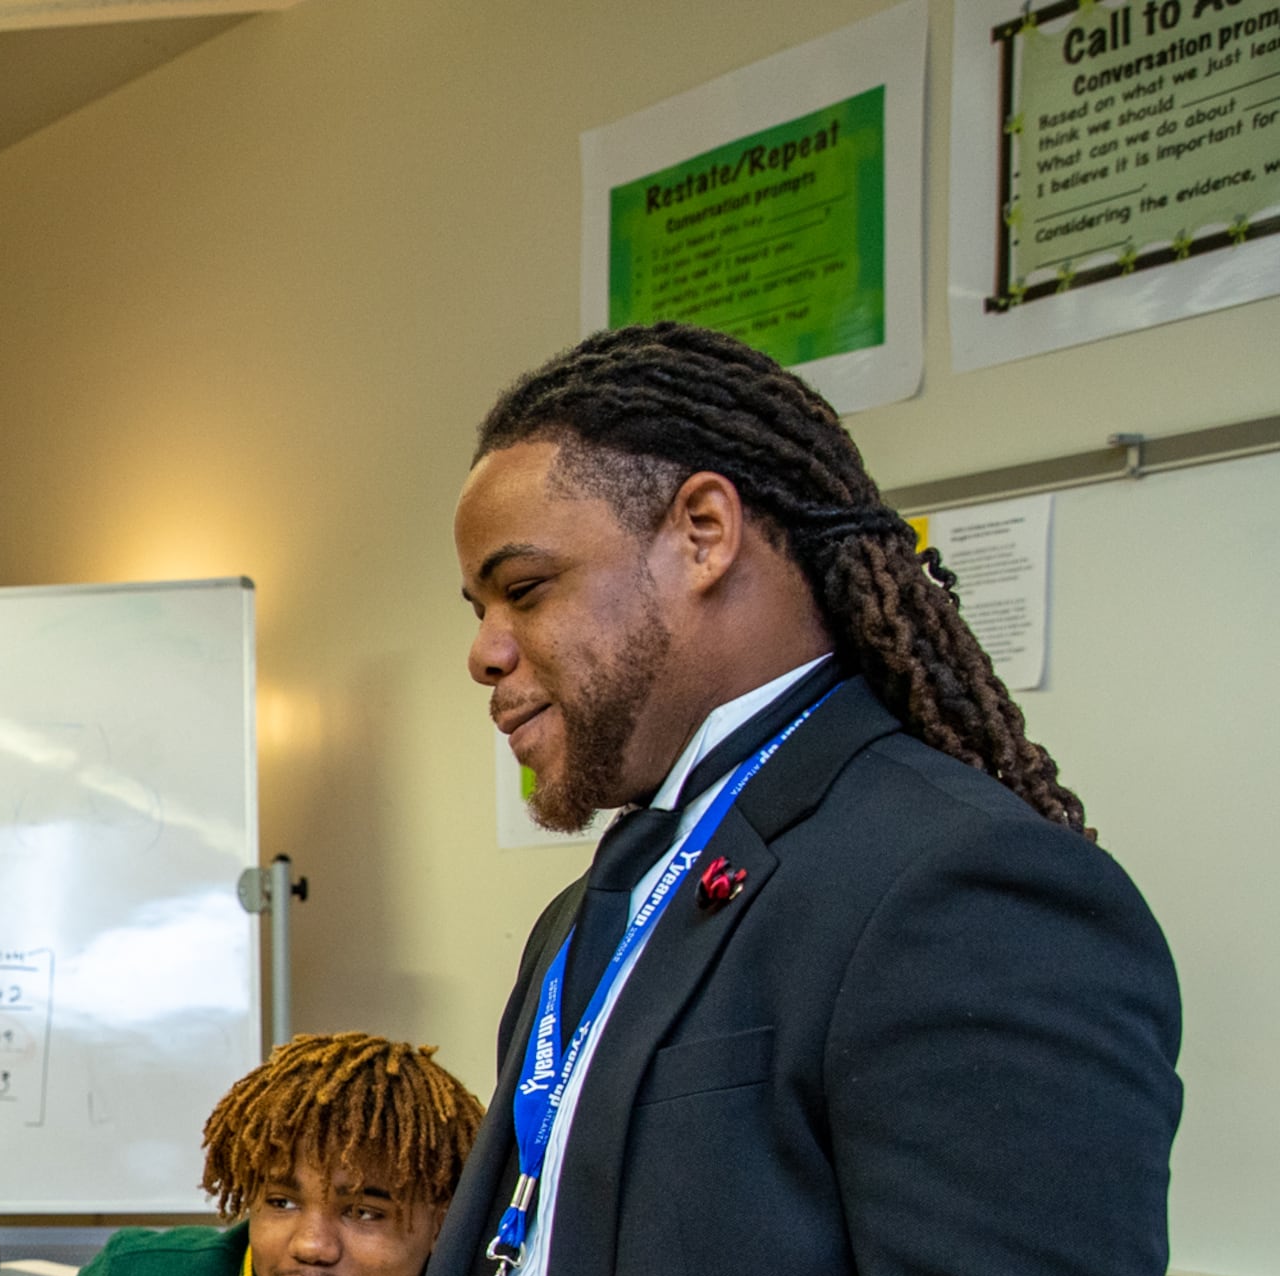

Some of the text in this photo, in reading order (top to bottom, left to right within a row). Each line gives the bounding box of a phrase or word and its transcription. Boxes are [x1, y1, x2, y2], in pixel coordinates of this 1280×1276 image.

[1063, 0, 1182, 65] Call to
[1072, 32, 1212, 96] Conversation
[1038, 49, 1241, 130] Based on what we just
[1038, 95, 1174, 151] think we should
[645, 118, 839, 215] Restate/Repeat
[1037, 98, 1236, 173] What can we do about
[1037, 108, 1278, 198] I believe it is important for
[666, 171, 815, 234] Conversation prompts
[1035, 205, 1132, 243] Considering
[1140, 193, 1168, 213] the
[1176, 169, 1256, 203] evidence,
